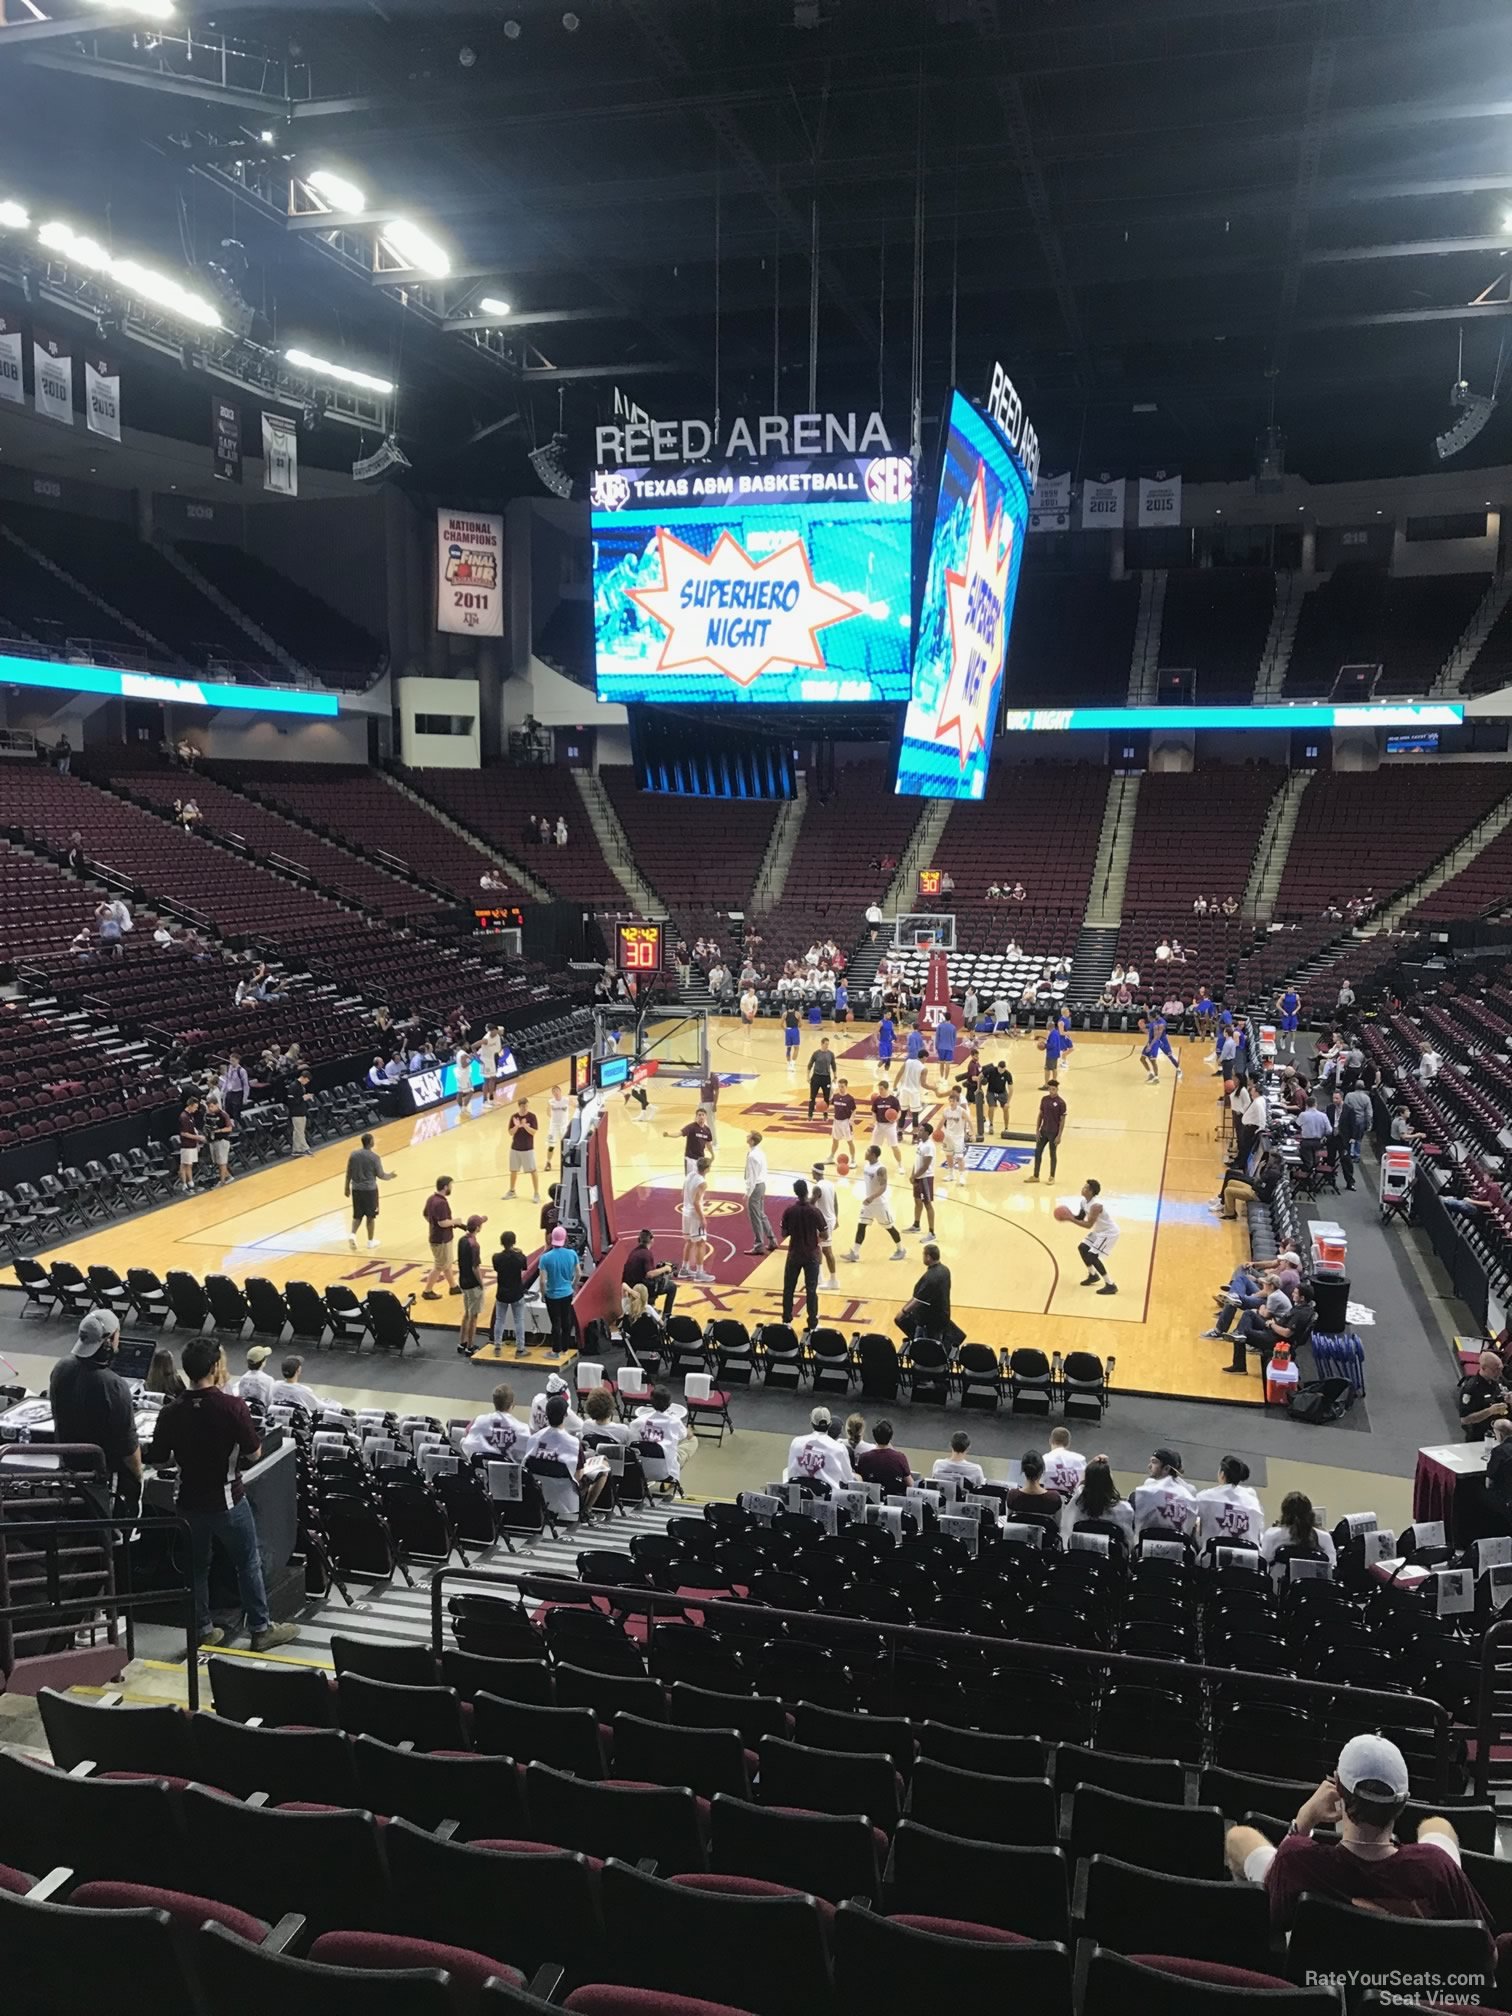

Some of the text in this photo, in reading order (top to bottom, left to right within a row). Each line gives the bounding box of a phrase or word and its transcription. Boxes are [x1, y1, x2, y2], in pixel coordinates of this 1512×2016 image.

[0, 361, 19, 380] 08
[42, 378, 67, 401] 2010
[91, 396, 115, 418] 2013
[988, 361, 1022, 448] REED
[595, 412, 892, 464] REED ARENA
[634, 472, 859, 498] TEXAS A&M BASKETBALL
[868, 459, 912, 503] SEC
[1090, 501, 1117, 513] 2012
[1146, 499, 1173, 511] 2015
[449, 519, 491, 534] NATIONAL
[443, 530, 497, 546] CHAMPIONS
[460, 550, 495, 566] FINAL
[454, 591, 488, 610] 2011
[680, 579, 799, 612] SUPERHERO
[706, 618, 771, 648] NIGHT
[922, 880, 938, 892] 30
[621, 928, 658, 942] 42:42
[626, 942, 653, 966] 30
